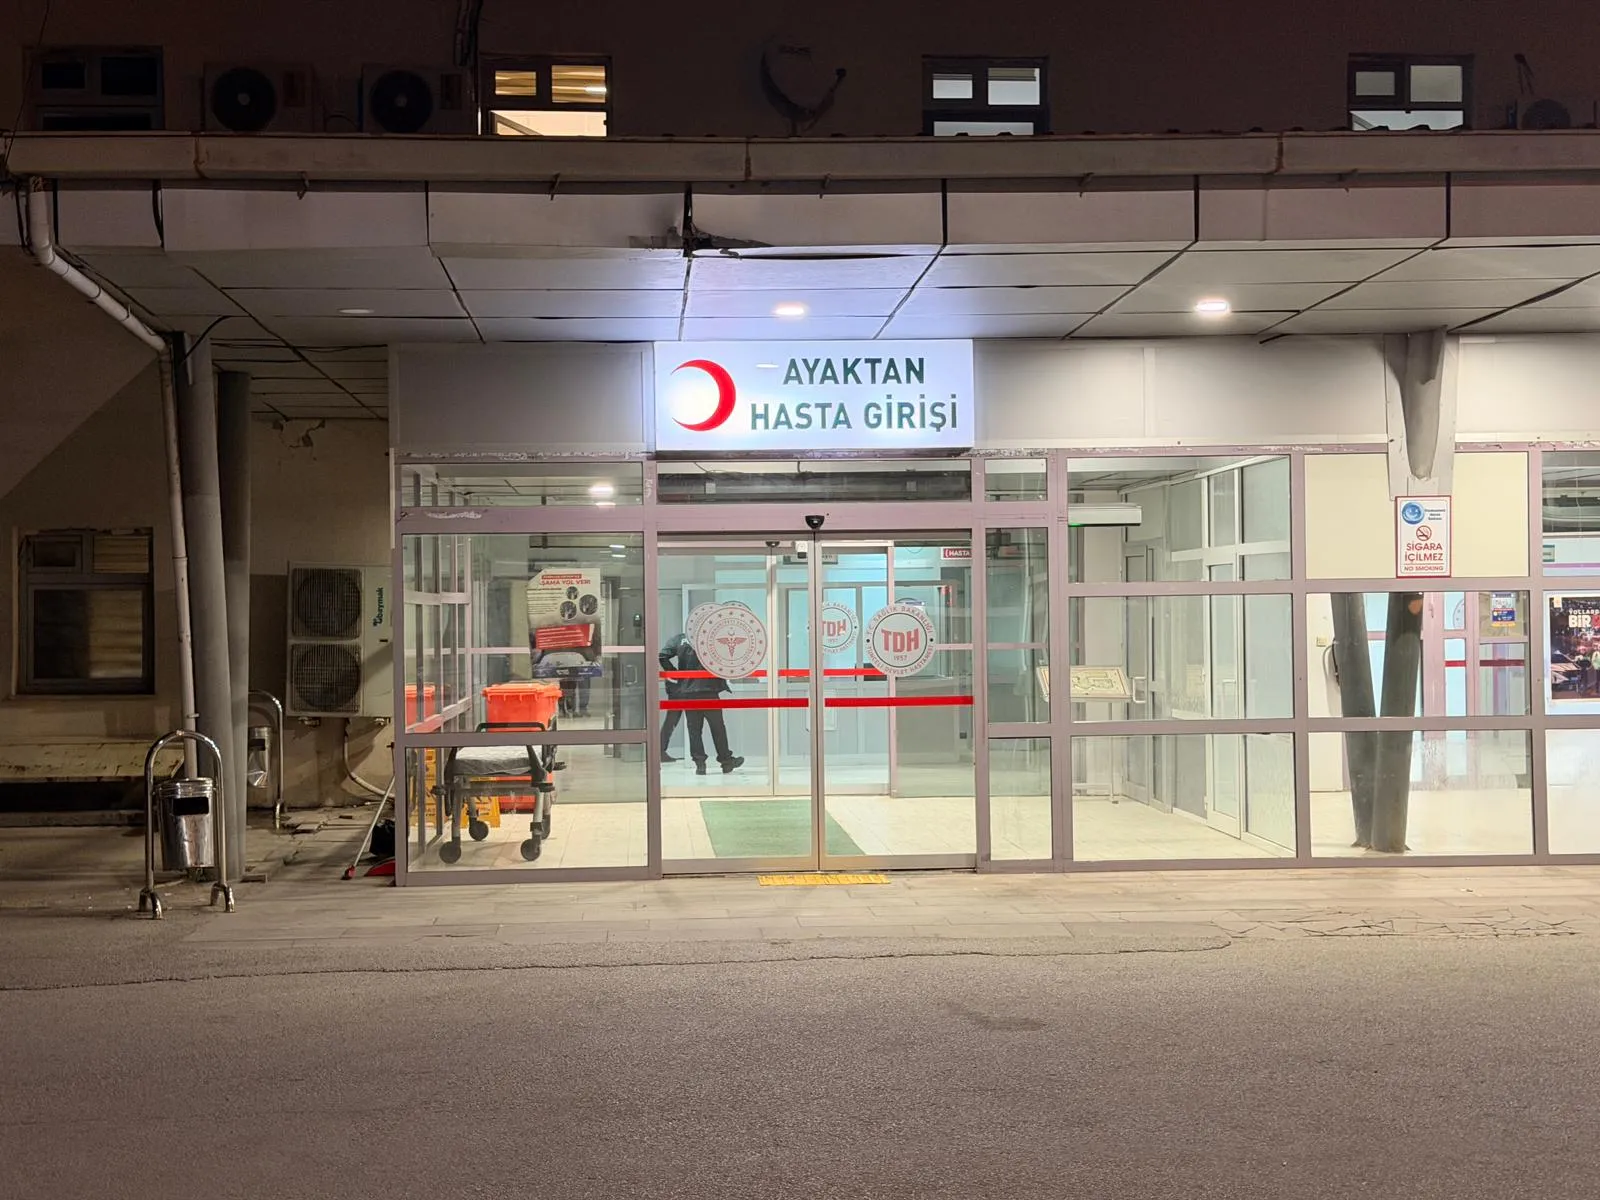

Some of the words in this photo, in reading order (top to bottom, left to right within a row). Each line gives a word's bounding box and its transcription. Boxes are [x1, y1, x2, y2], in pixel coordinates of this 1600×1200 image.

[782, 357, 925, 385] AYAKTAN
[751, 402, 853, 430] HASTA
[863, 394, 957, 432] GİRİŞİ
[1404, 552, 1444, 563] İÇİLMEZ
[1406, 541, 1443, 551] SİGARA
[881, 628, 920, 653] TDH
